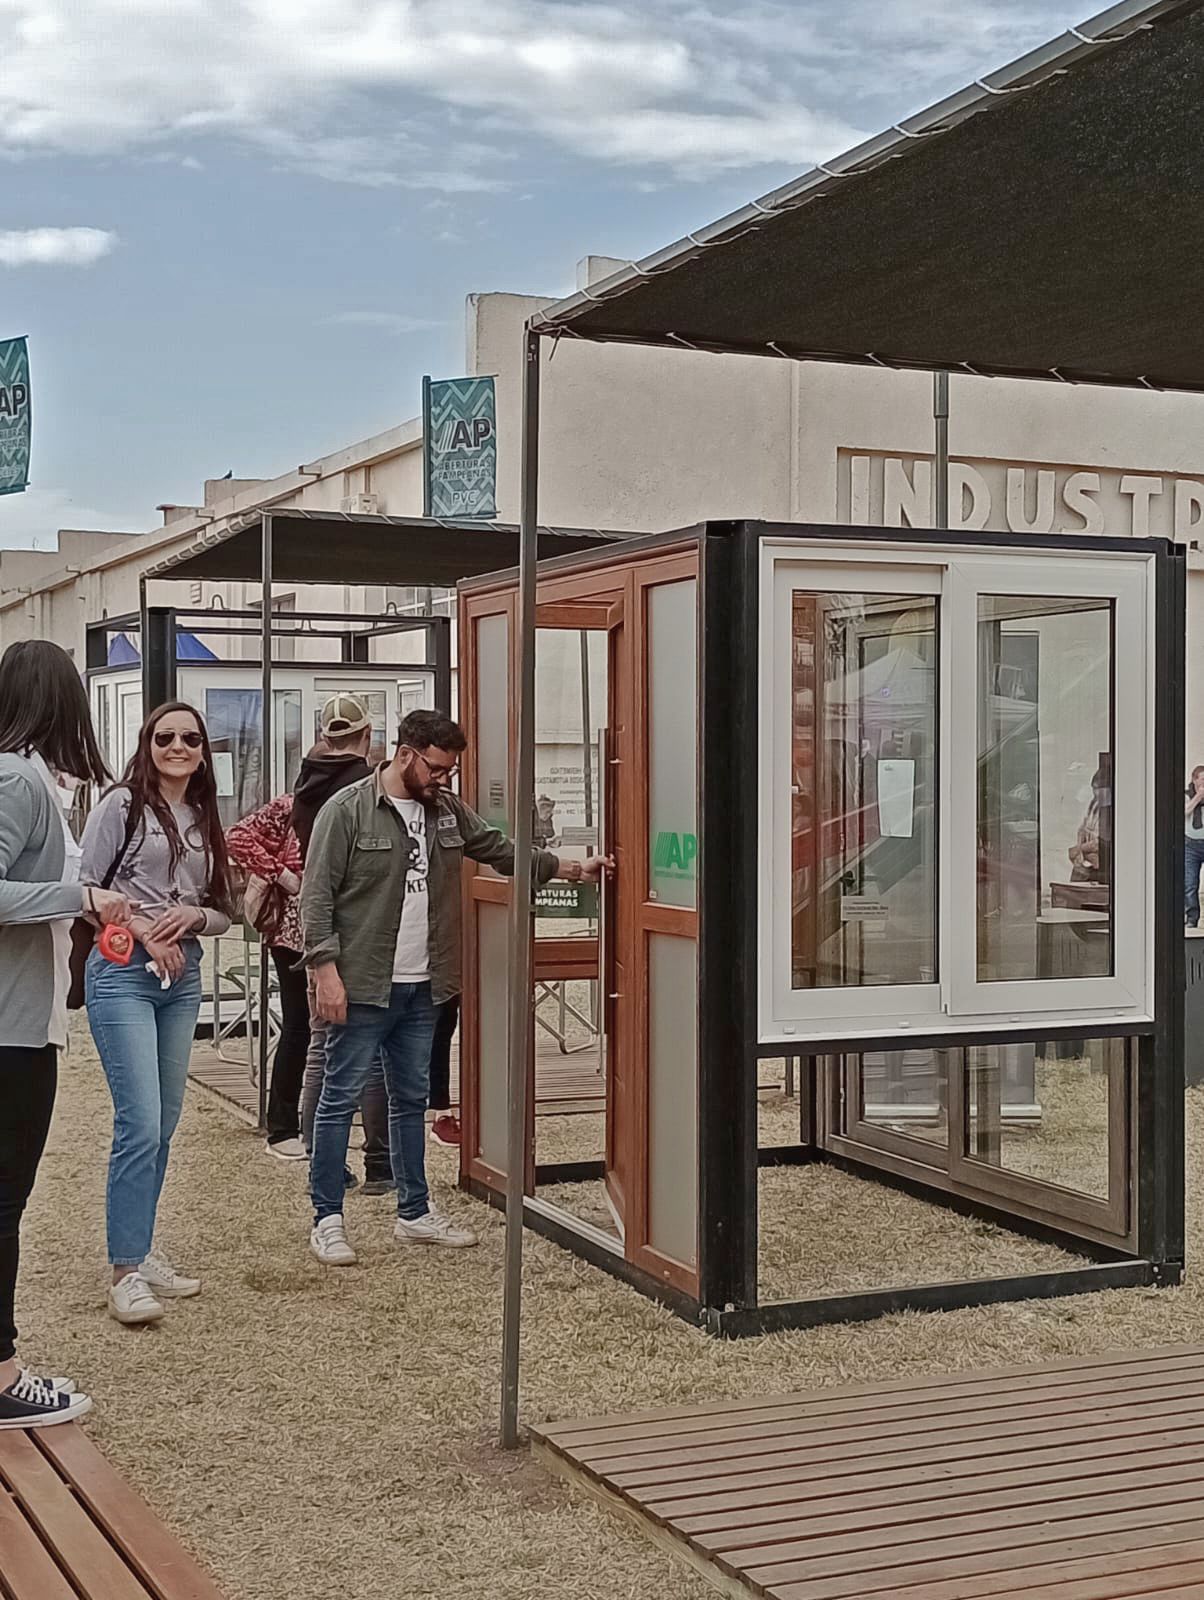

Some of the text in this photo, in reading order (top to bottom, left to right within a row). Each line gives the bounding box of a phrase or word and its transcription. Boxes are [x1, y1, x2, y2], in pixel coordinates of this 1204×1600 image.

[0, 384, 26, 416] AP
[451, 418, 491, 449] AP
[439, 459, 491, 471] ABERTURAS
[453, 491, 477, 505] PVC
[665, 832, 697, 869] AP
